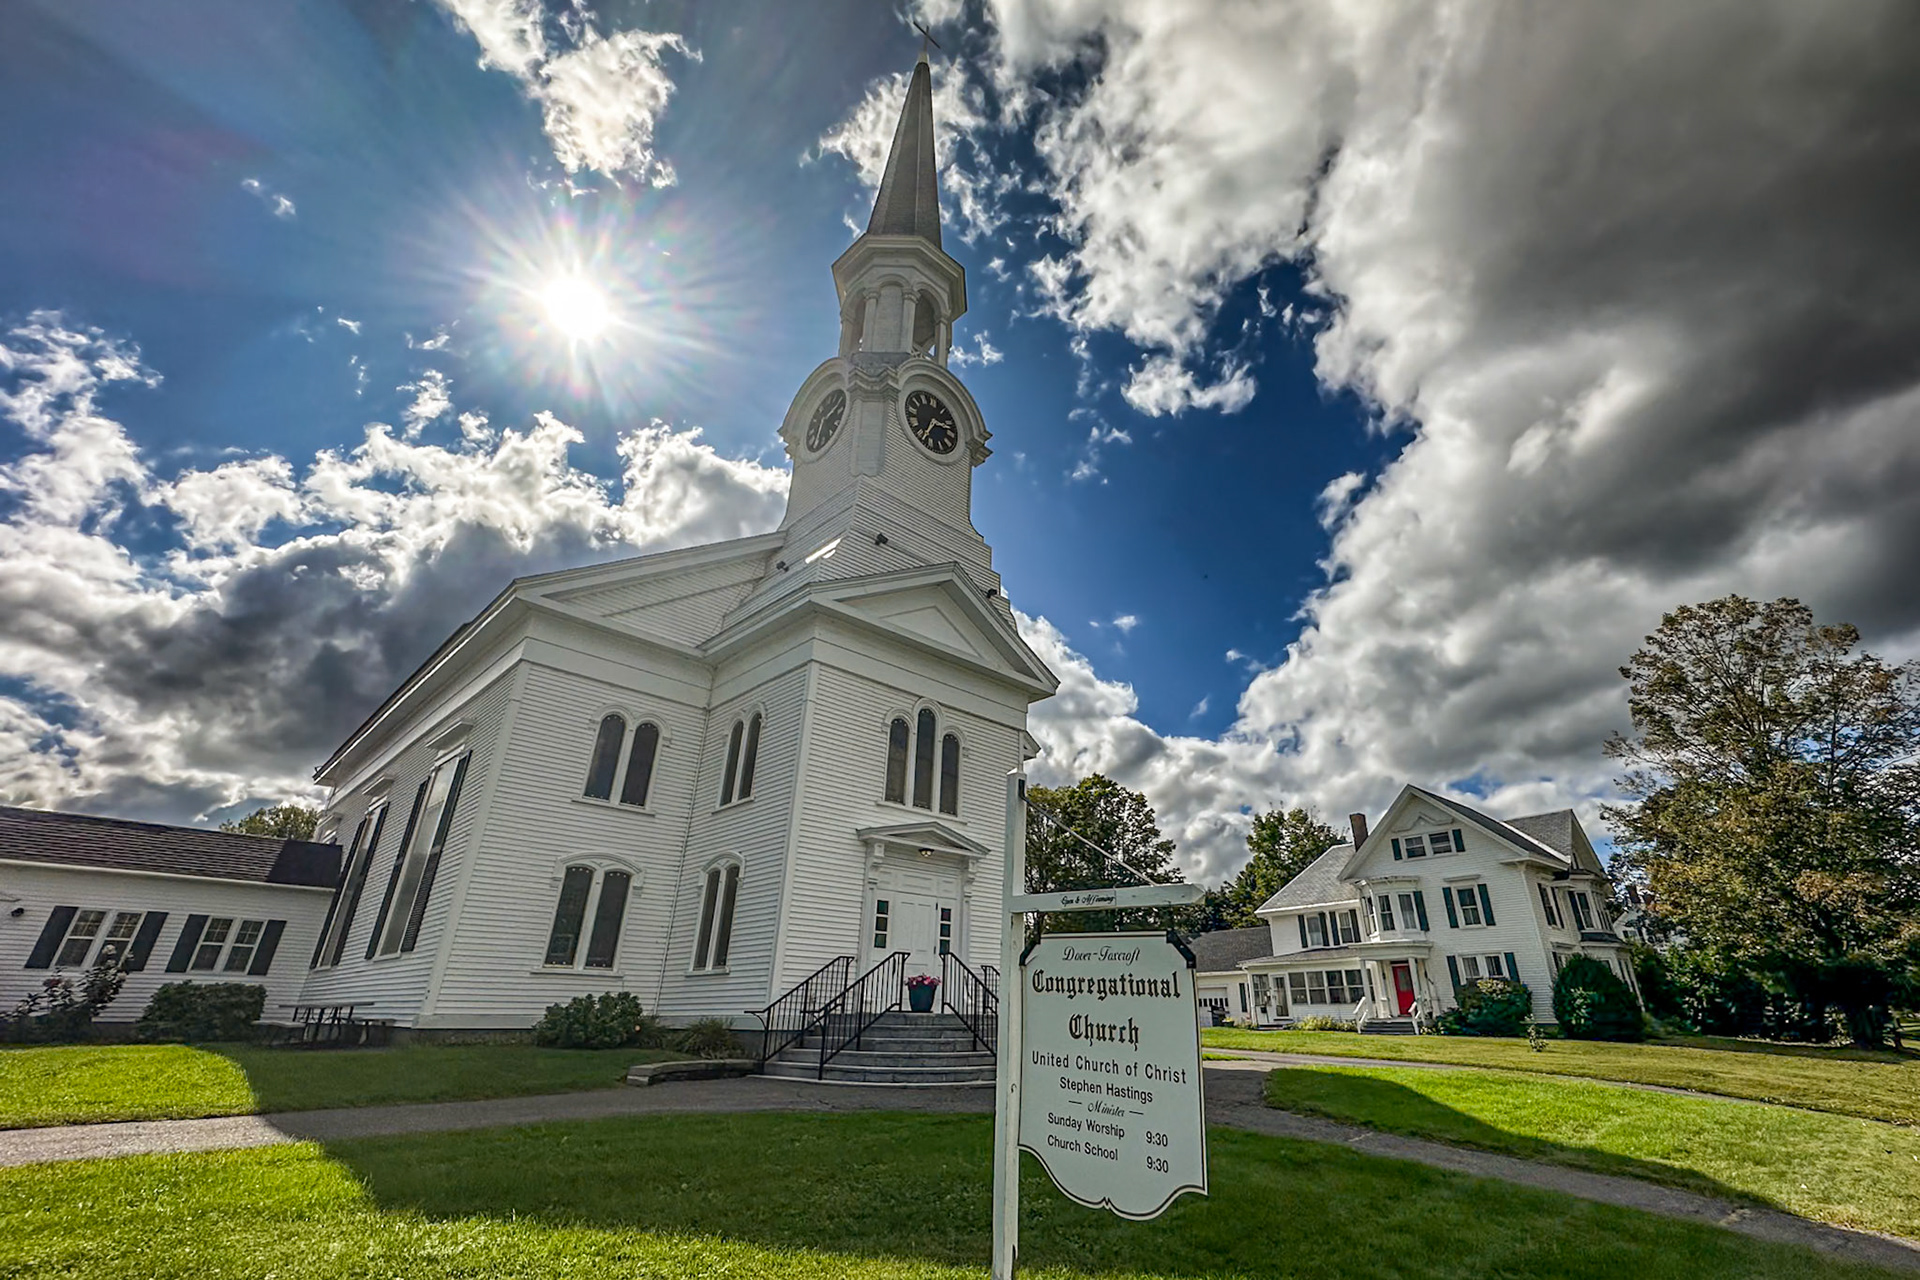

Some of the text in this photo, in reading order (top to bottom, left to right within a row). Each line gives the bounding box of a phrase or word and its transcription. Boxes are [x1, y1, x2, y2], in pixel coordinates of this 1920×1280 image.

[1032, 969, 1181, 1001] Congregational
[1069, 1013, 1139, 1051] Church
[1032, 1050, 1187, 1084] United Church of Christ
[1059, 1077, 1153, 1104] Stephen Hastings
[1087, 1100, 1125, 1117] Minister
[1047, 1113, 1169, 1147] Sunday Worship 9:30
[1047, 1135, 1169, 1173] Church School 9:30
